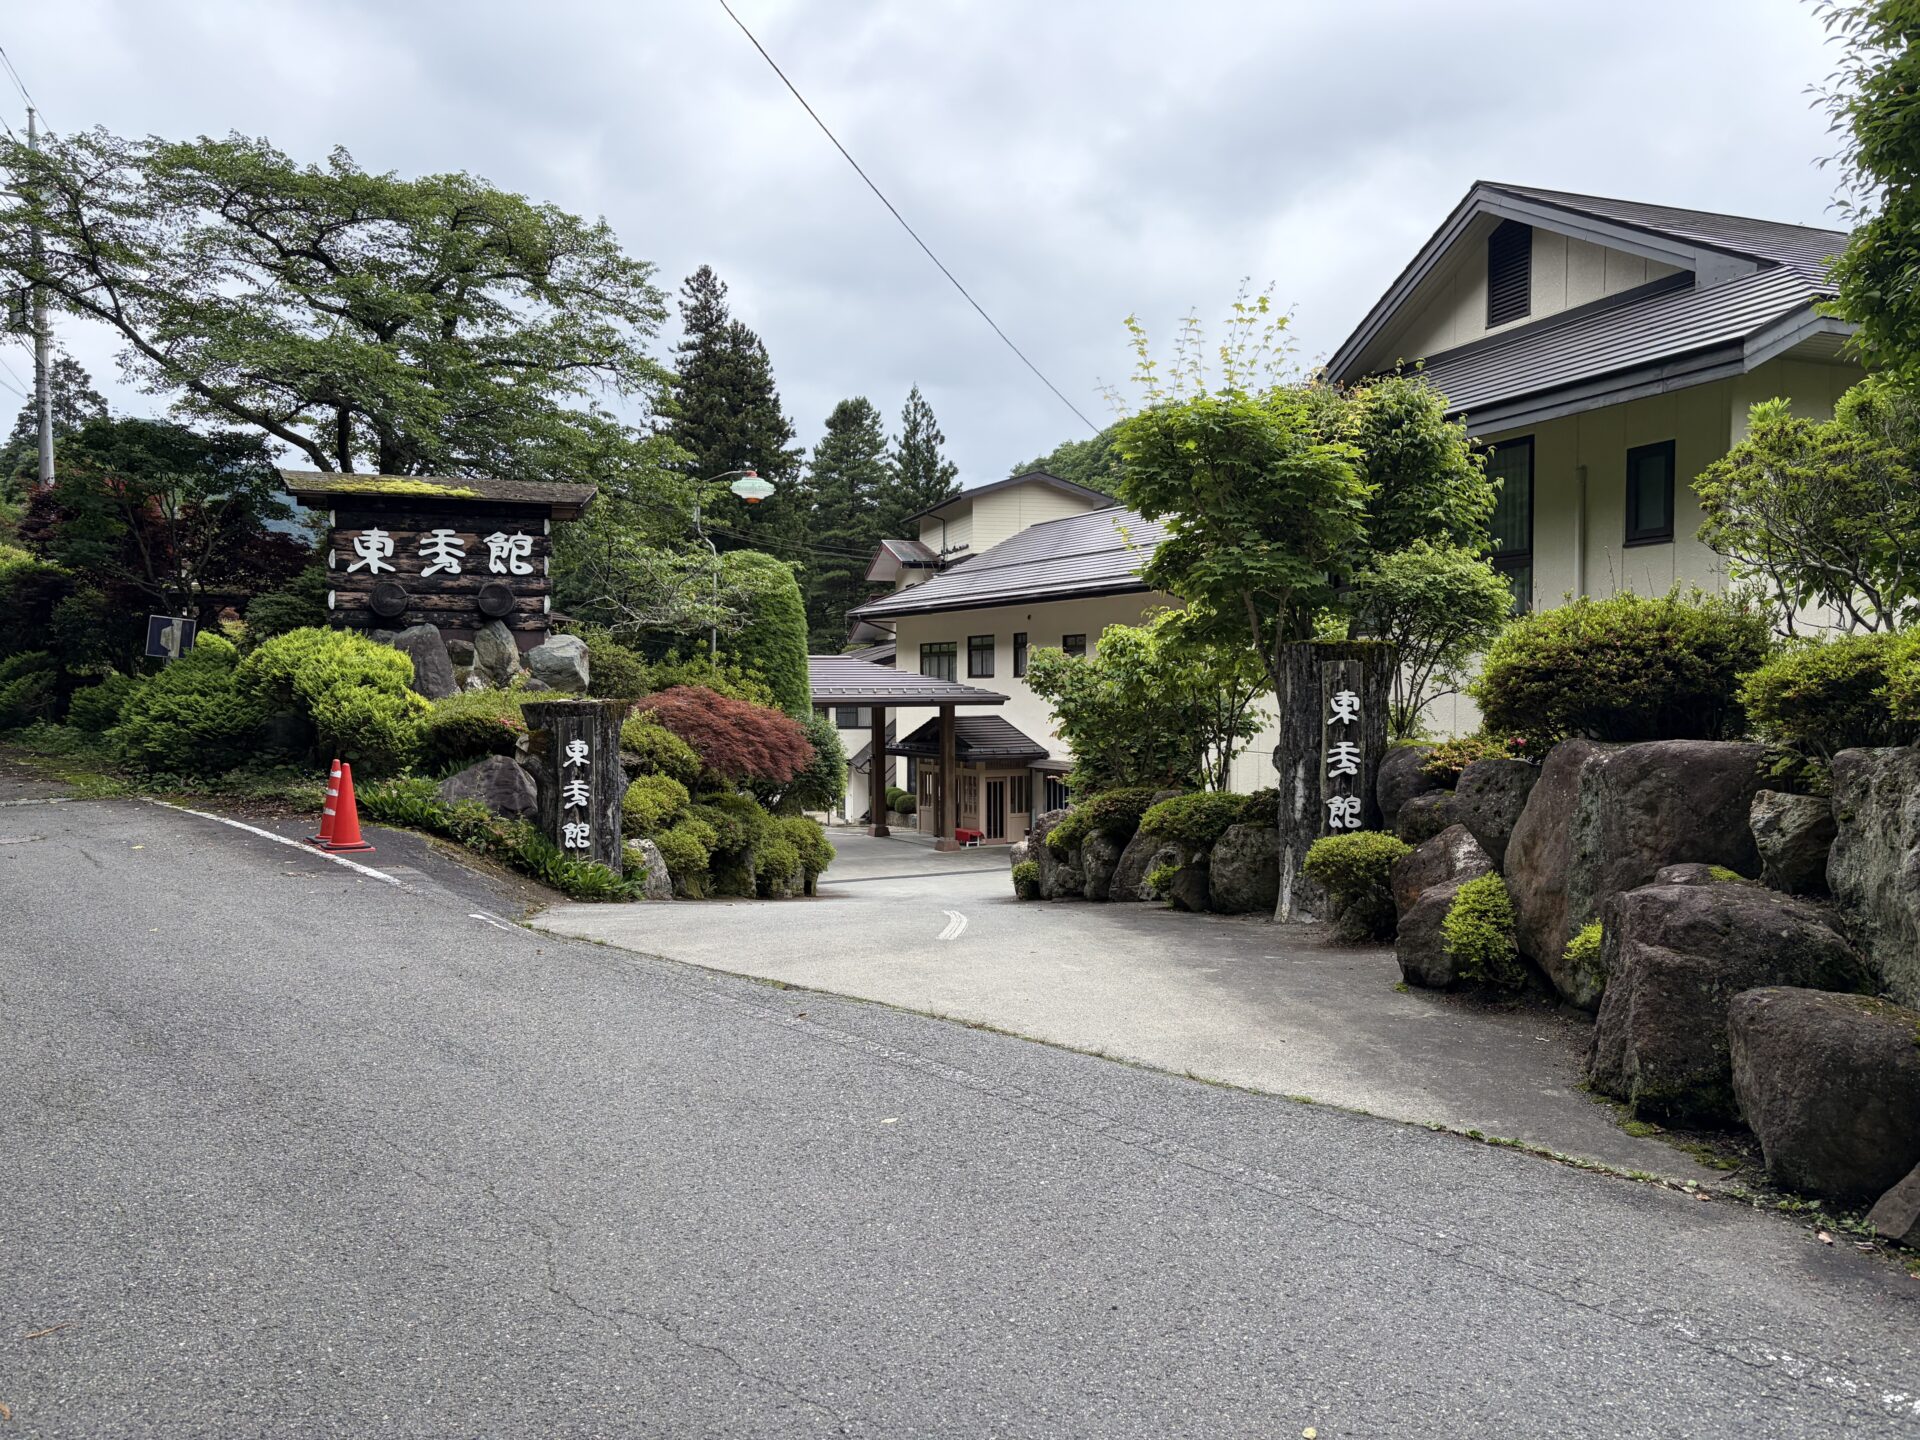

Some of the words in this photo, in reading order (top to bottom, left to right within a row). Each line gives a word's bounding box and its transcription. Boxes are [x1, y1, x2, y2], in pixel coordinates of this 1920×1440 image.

[346, 527, 534, 578] 東秀館
[562, 739, 591, 849] 東秀館
[1326, 689, 1362, 829] 東秀館
